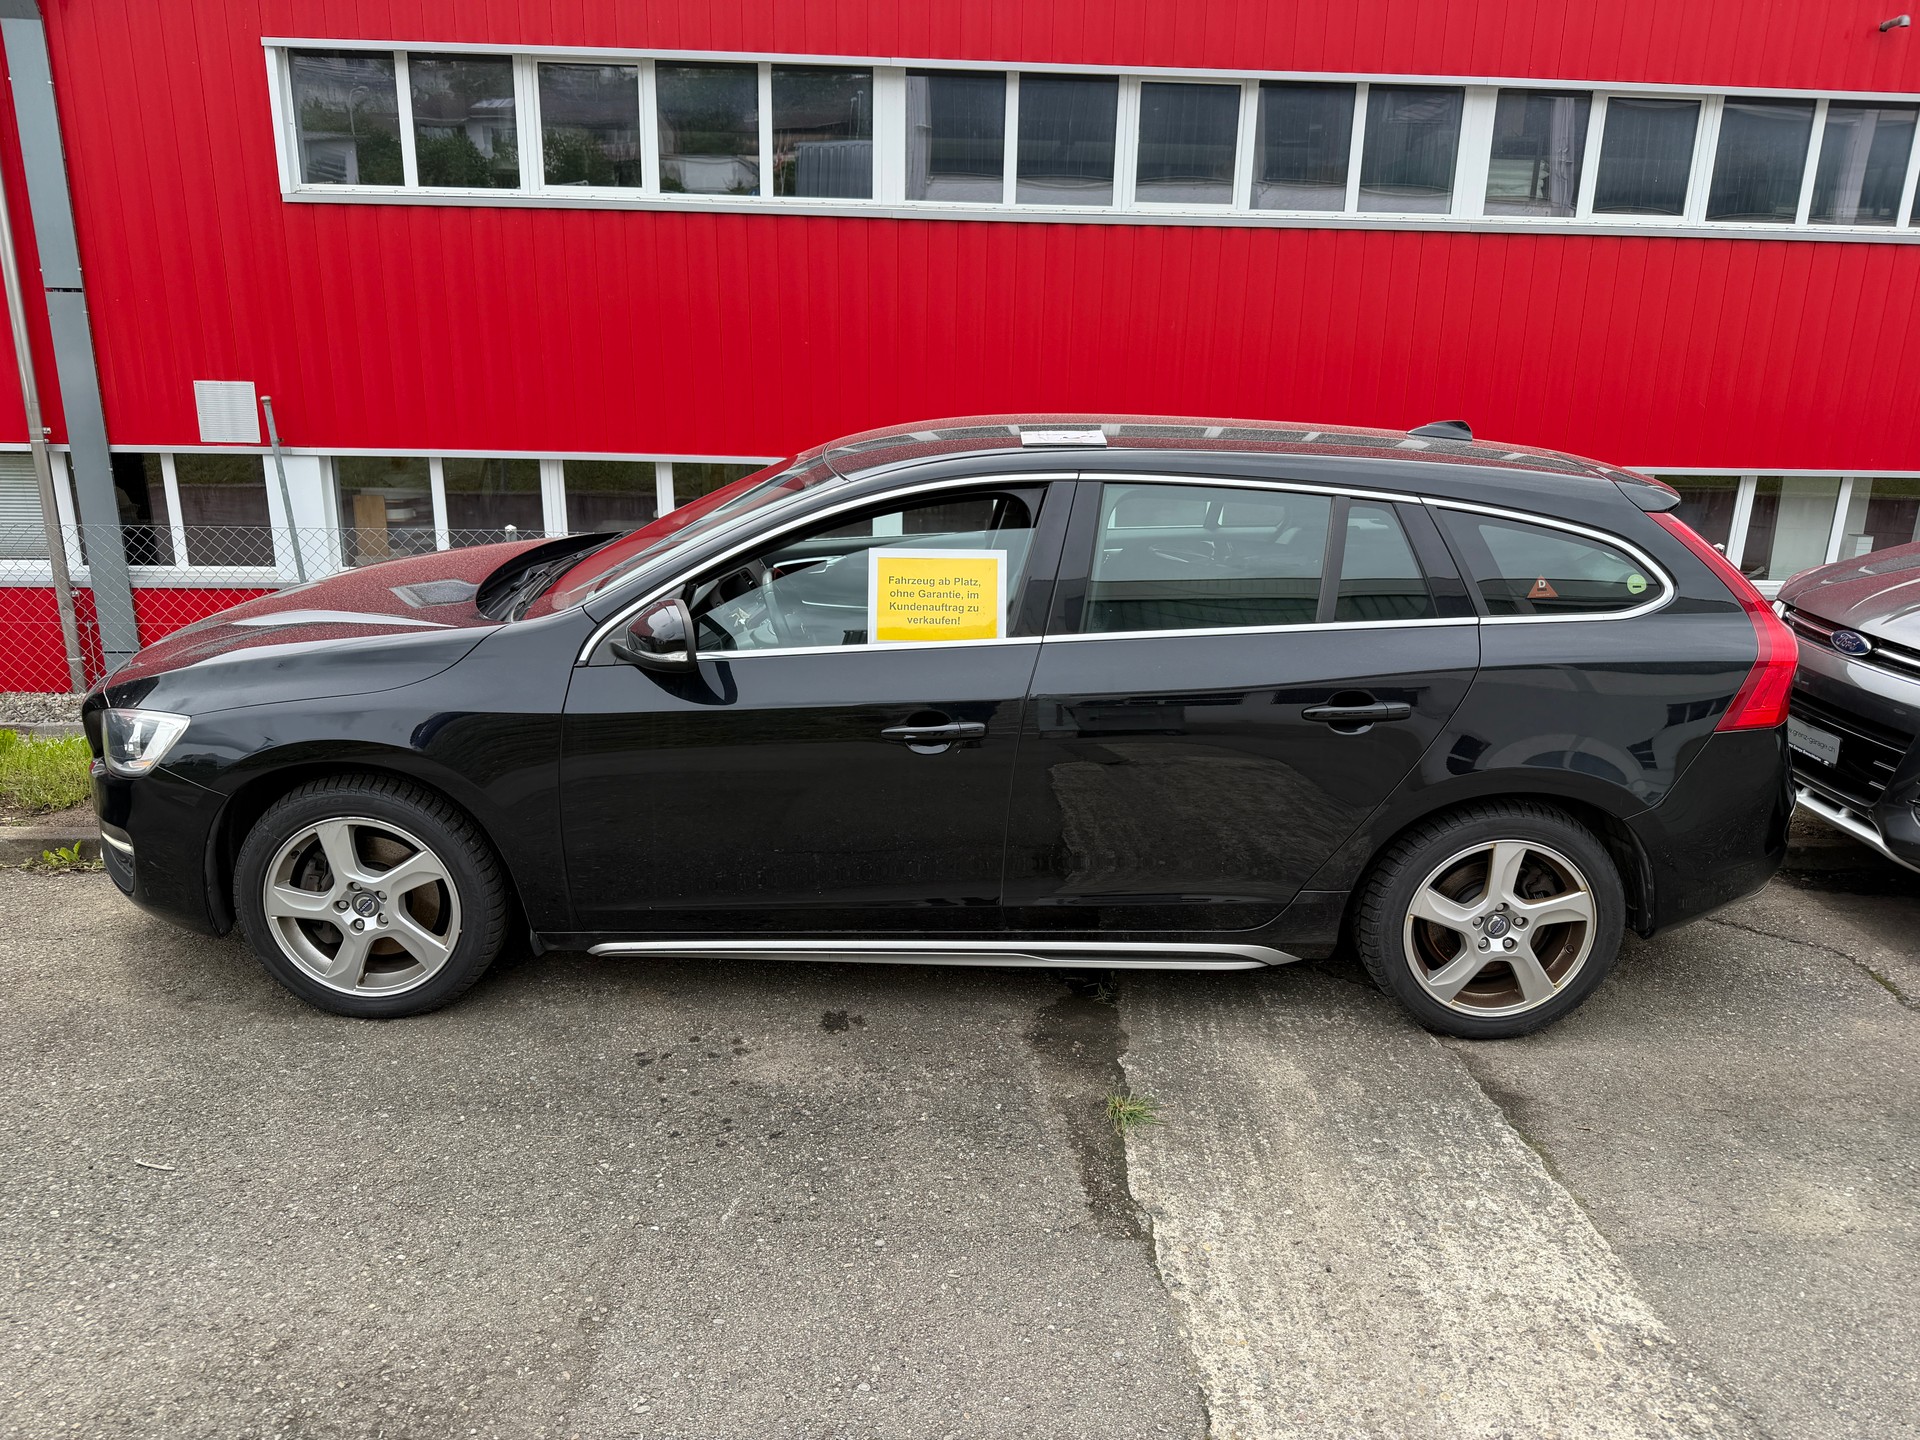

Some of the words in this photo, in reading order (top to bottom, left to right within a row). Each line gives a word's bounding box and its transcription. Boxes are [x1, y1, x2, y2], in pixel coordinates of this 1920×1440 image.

[888, 575, 936, 587] Fahrzeug
[938, 577, 951, 586] ab
[954, 577, 981, 587] Platz,
[1538, 579, 1546, 588] D
[889, 589, 915, 598] ohne
[918, 589, 964, 600] Garantie,
[967, 590, 979, 599] im
[889, 602, 965, 613] Kundenauftrag
[967, 604, 979, 612] zu
[907, 615, 961, 625] verkaufen!
[1836, 632, 1860, 650] Ford
